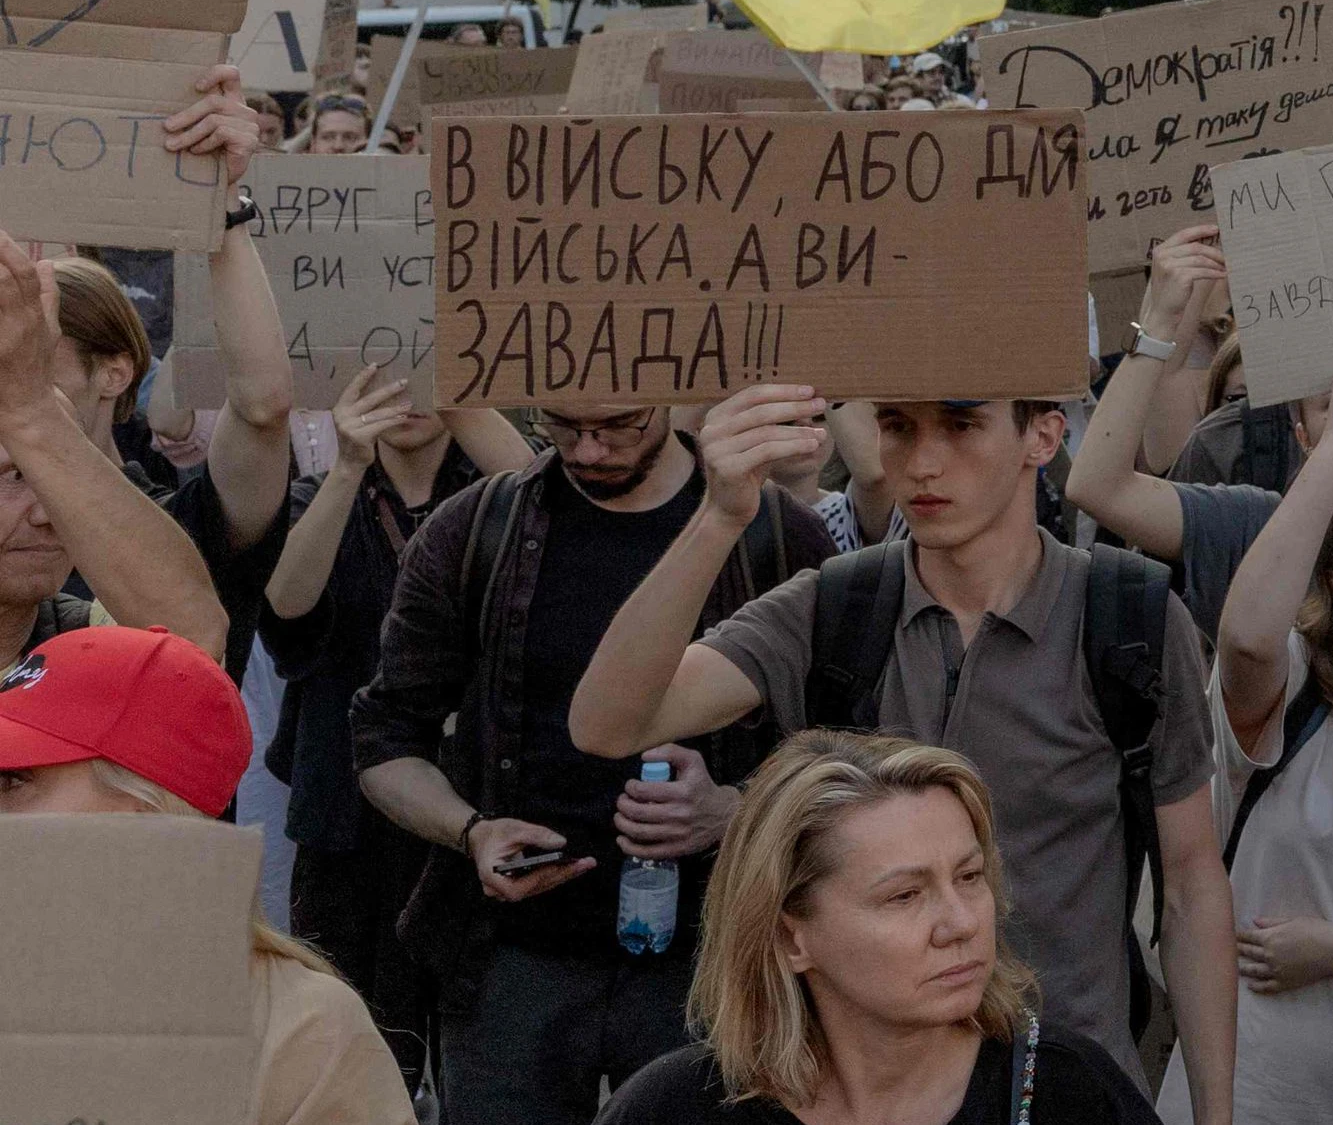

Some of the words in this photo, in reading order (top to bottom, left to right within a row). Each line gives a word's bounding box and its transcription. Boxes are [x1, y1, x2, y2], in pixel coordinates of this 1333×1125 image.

[446, 123, 476, 210] В
[506, 117, 784, 219] ВІЙСЬКУ,
[814, 129, 945, 205] АБО
[975, 122, 1081, 201] ДЛЯ
[1229, 172, 1296, 230] МИ
[293, 254, 345, 292] ВИ
[454, 299, 785, 404] ЗАВАДА!!!
